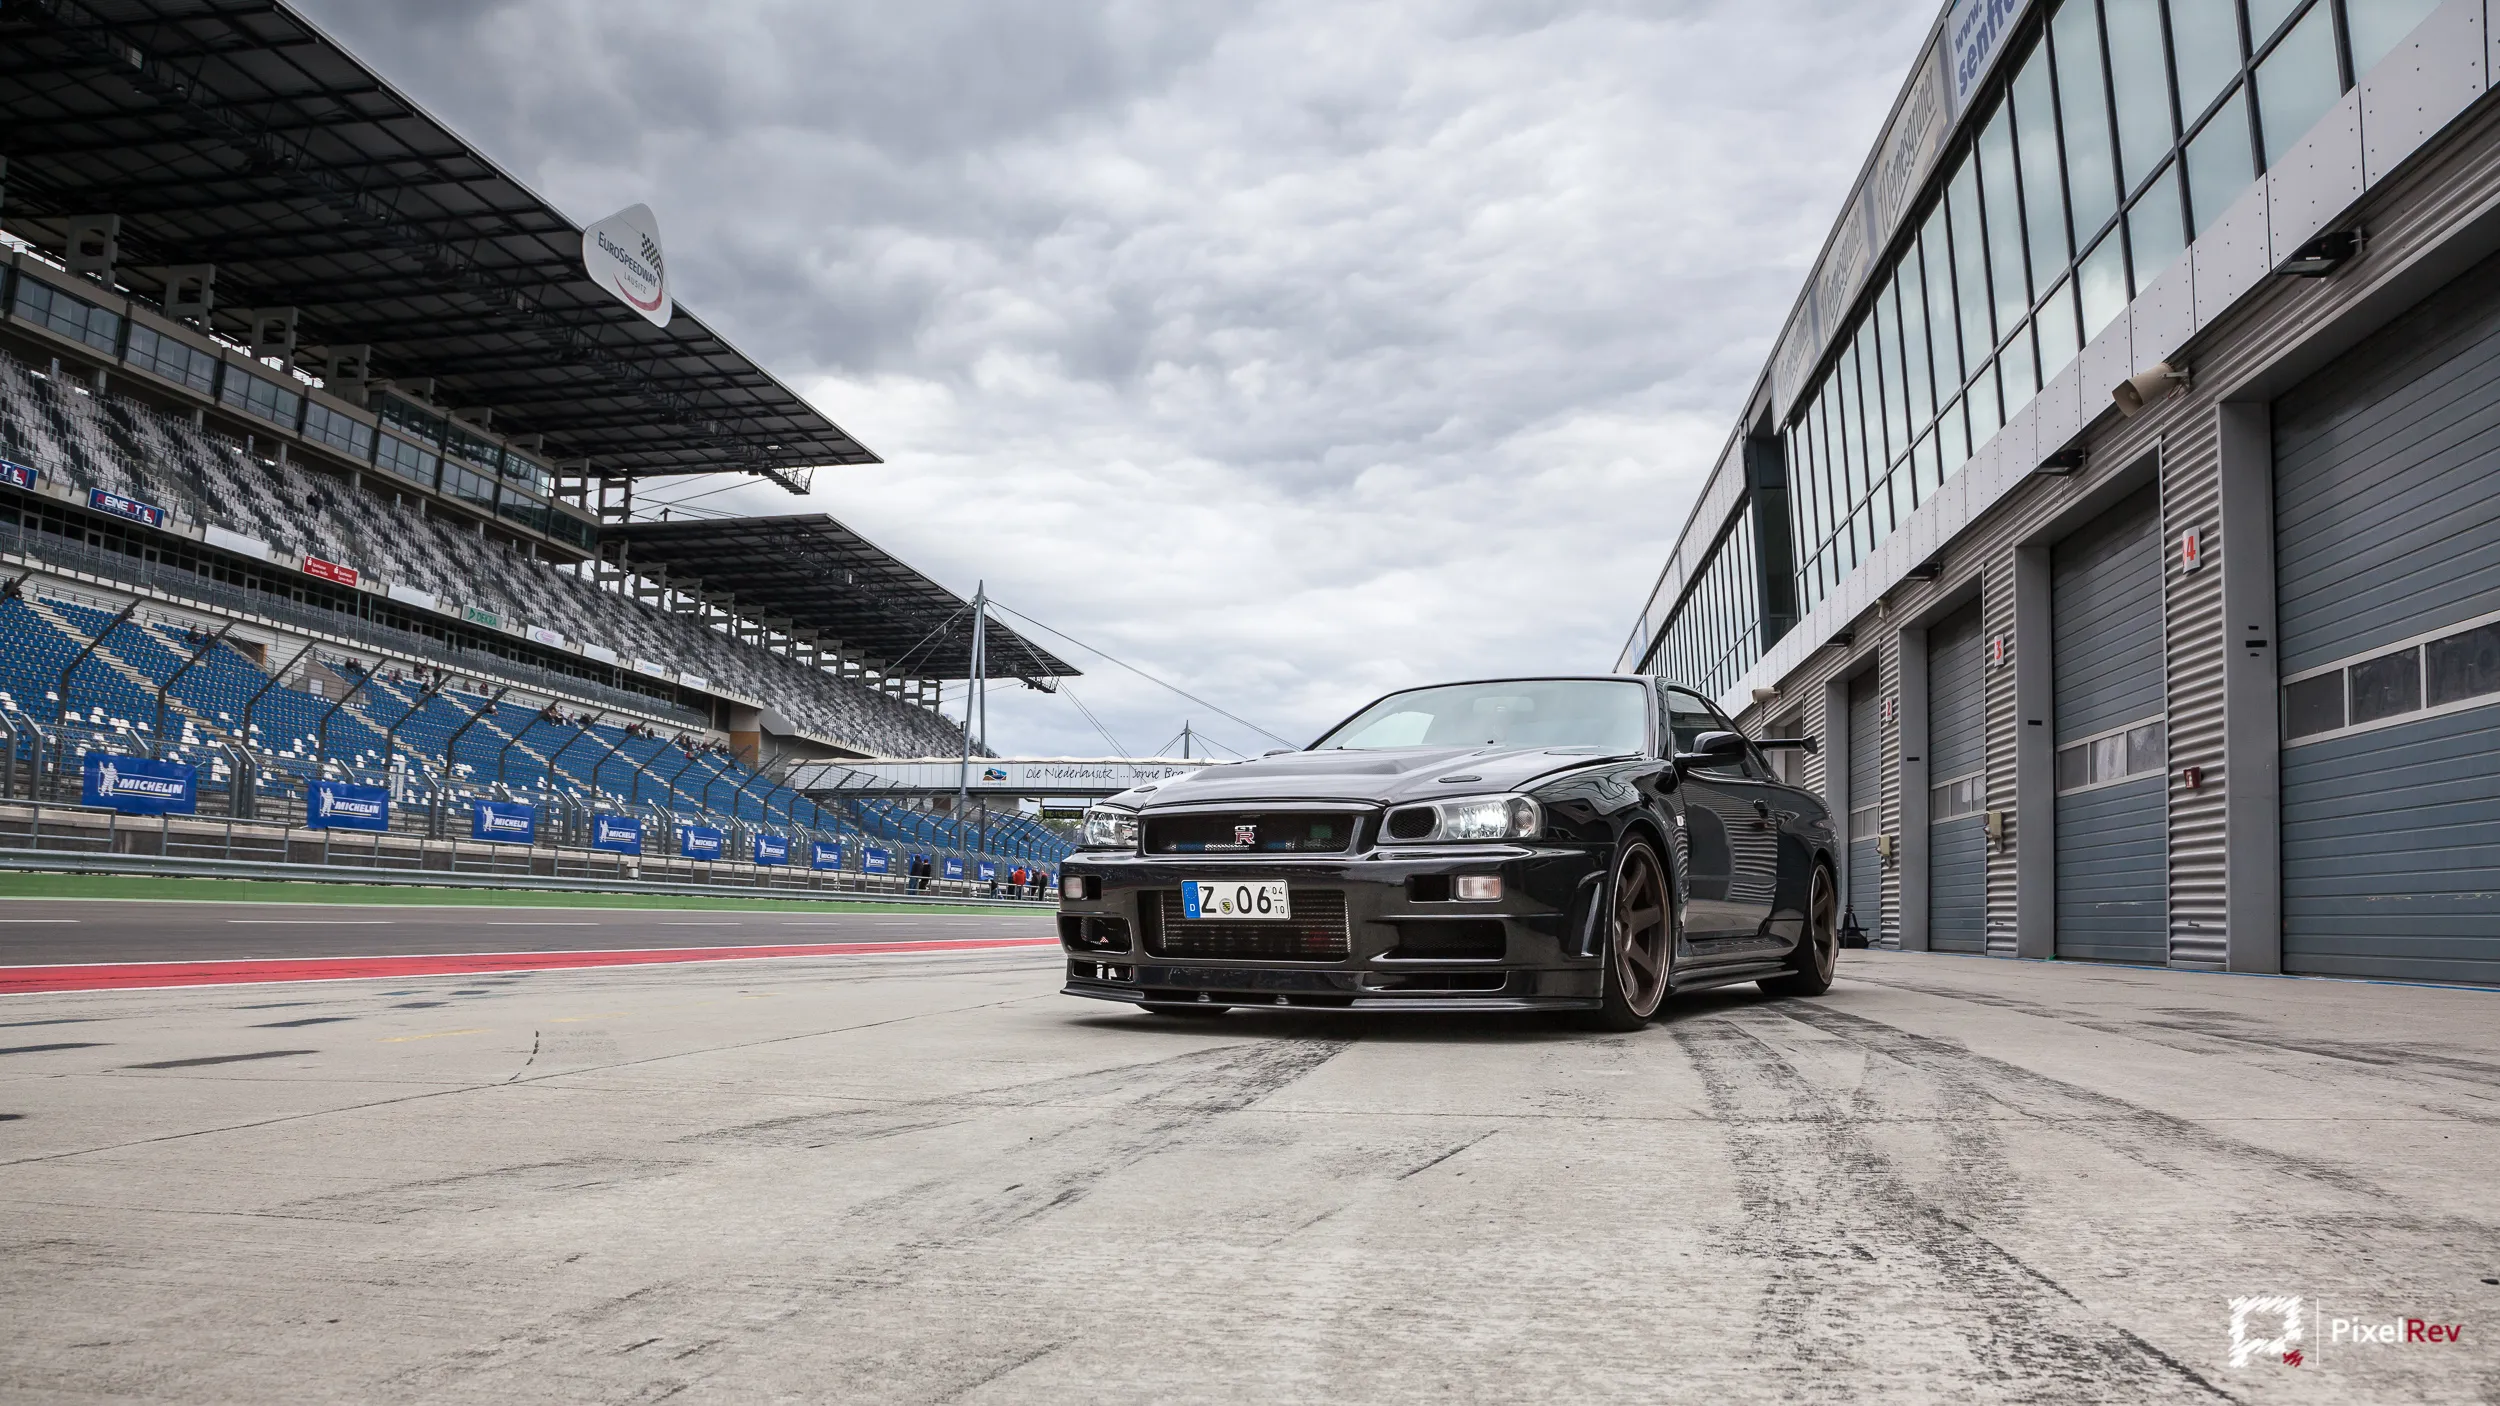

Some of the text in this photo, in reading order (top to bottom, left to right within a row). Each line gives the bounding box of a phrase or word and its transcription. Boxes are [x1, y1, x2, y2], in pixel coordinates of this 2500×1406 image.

[2187, 535, 2197, 561] 4
[476, 612, 497, 626] DEKRA
[1996, 640, 2003, 660] 3
[1026, 767, 1041, 779] Die
[1045, 765, 1115, 780] Niederlausitz
[119, 778, 183, 794] MICHELIN
[334, 801, 379, 815] MICHELIN
[494, 817, 529, 829] MICHELIN
[608, 830, 637, 840] MICHELIN
[1272, 886, 1283, 895] 04
[1189, 886, 1272, 914] D Z 06
[1274, 906, 1285, 914] 10
